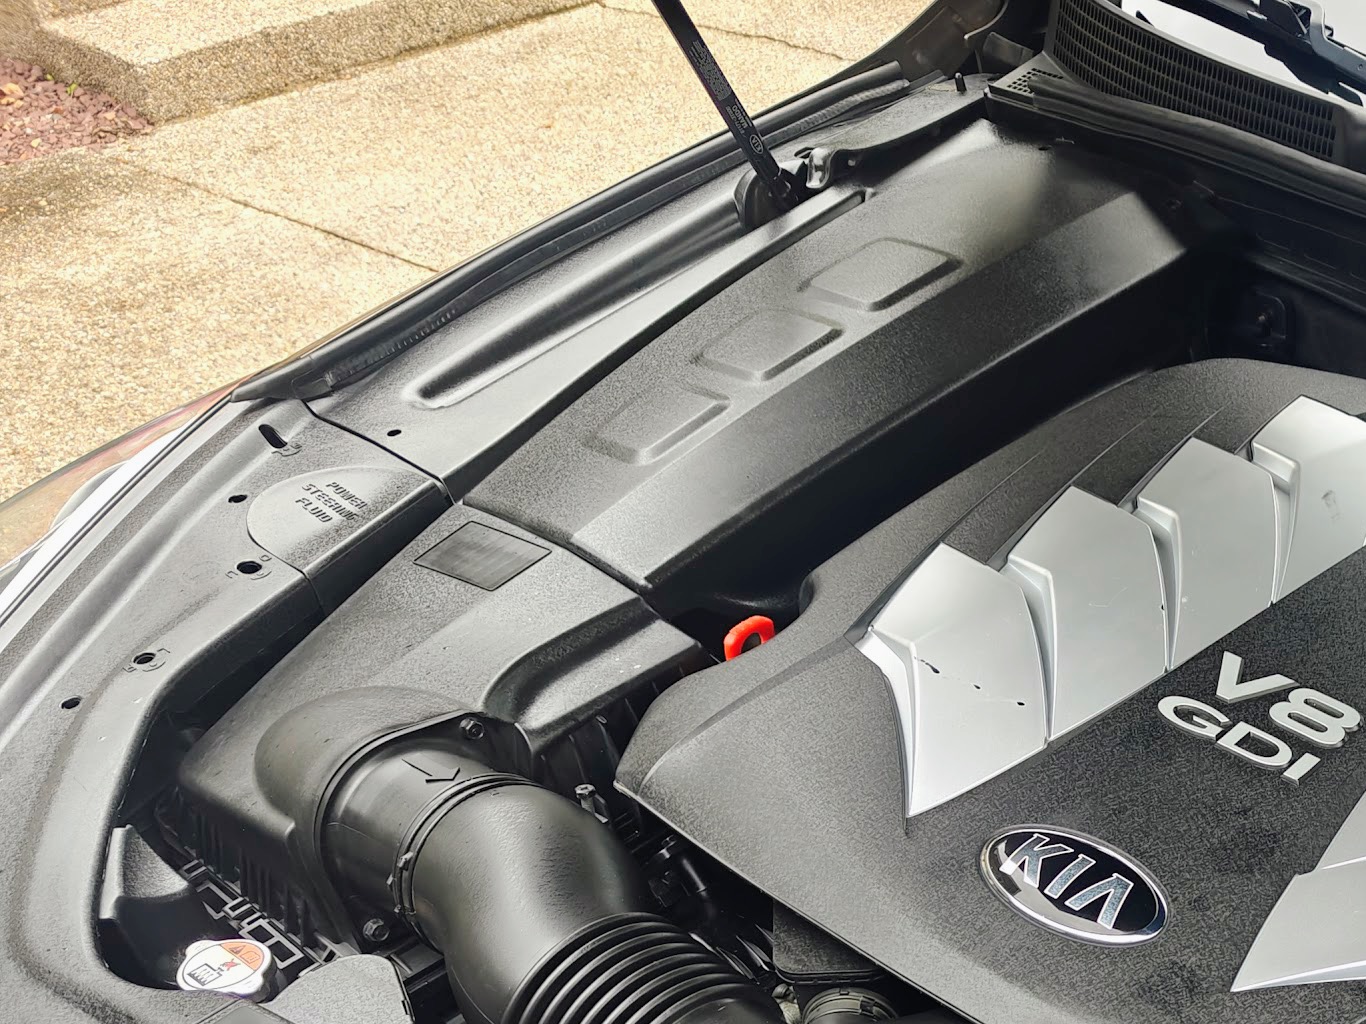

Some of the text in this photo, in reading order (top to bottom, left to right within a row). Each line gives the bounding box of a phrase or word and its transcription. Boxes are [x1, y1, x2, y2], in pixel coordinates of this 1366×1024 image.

[732, 105, 748, 128] MANDO
[295, 498, 333, 522] FLUID
[302, 484, 359, 521] STEERING
[326, 482, 367, 509] POWER
[1215, 650, 1361, 748] V8
[1158, 695, 1321, 786] GDI
[999, 833, 1134, 930] KIA
